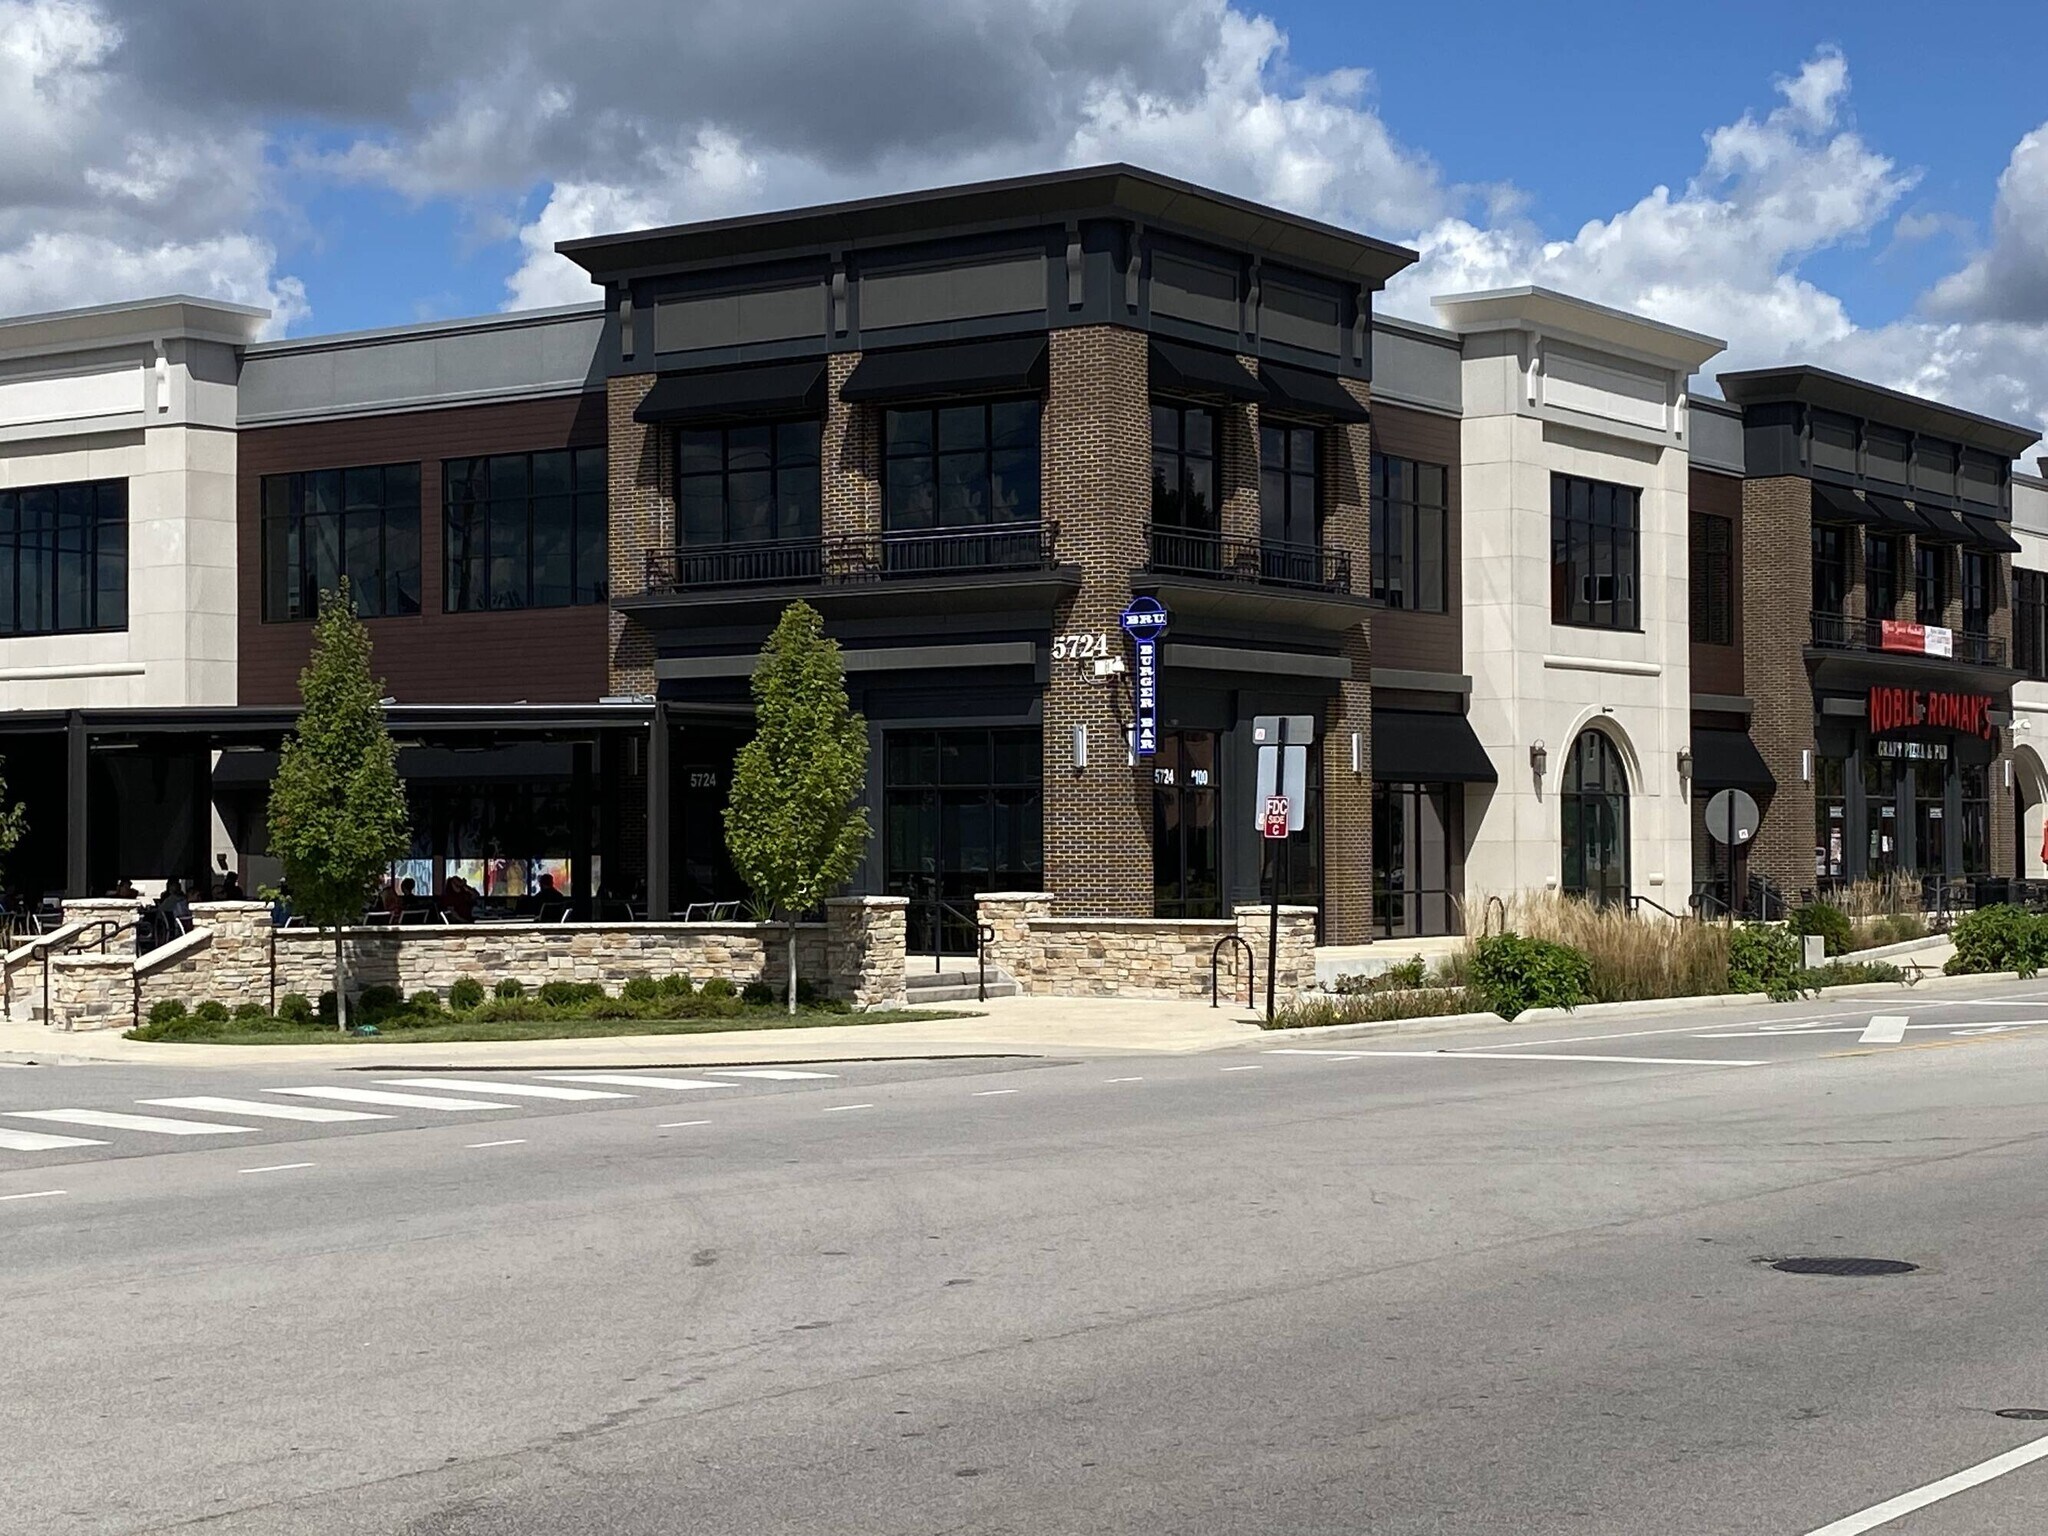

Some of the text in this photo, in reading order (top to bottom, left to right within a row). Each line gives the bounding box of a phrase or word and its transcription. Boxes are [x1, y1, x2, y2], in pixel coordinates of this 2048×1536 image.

[1126, 614, 1164, 625] BRU
[1051, 633, 1108, 660] 5724
[1140, 645, 1155, 749] BURGER BAR
[1871, 686, 1992, 740] NOBLE ROMAN'S
[1878, 740, 1902, 758] CRAFT
[1904, 742, 1925, 758] PIZZA
[690, 772, 716, 787] 5724
[1154, 768, 1174, 785] 5724
[1266, 799, 1288, 815] FDC
[1267, 815, 1285, 825] SIDE
[1272, 824, 1280, 836] C
